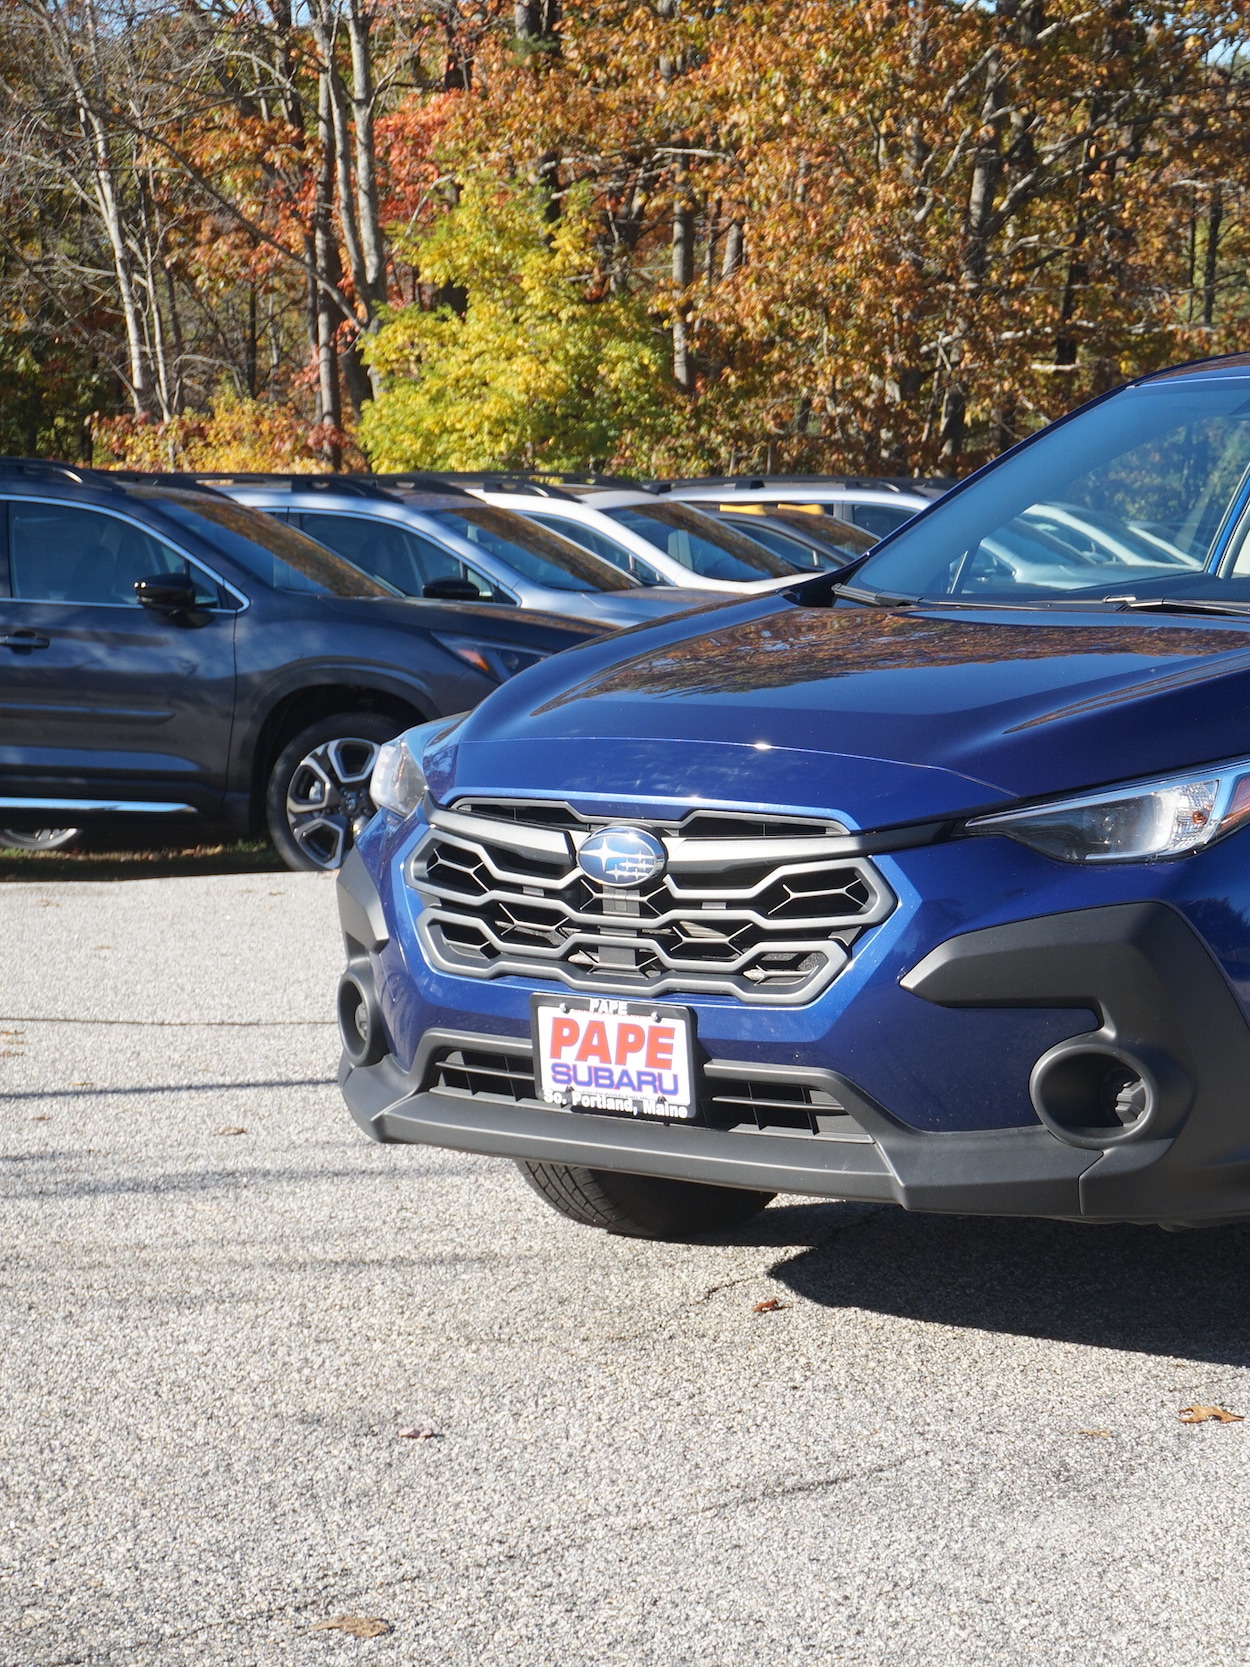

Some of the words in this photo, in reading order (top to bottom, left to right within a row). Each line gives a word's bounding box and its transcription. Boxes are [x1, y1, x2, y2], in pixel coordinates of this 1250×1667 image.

[589, 998, 628, 1015] PAPE
[550, 1017, 676, 1070] PAPE
[550, 1062, 679, 1096] SUBARU
[543, 1088, 567, 1104] So.
[571, 1090, 637, 1116] Portland,
[643, 1099, 688, 1119] Maine
